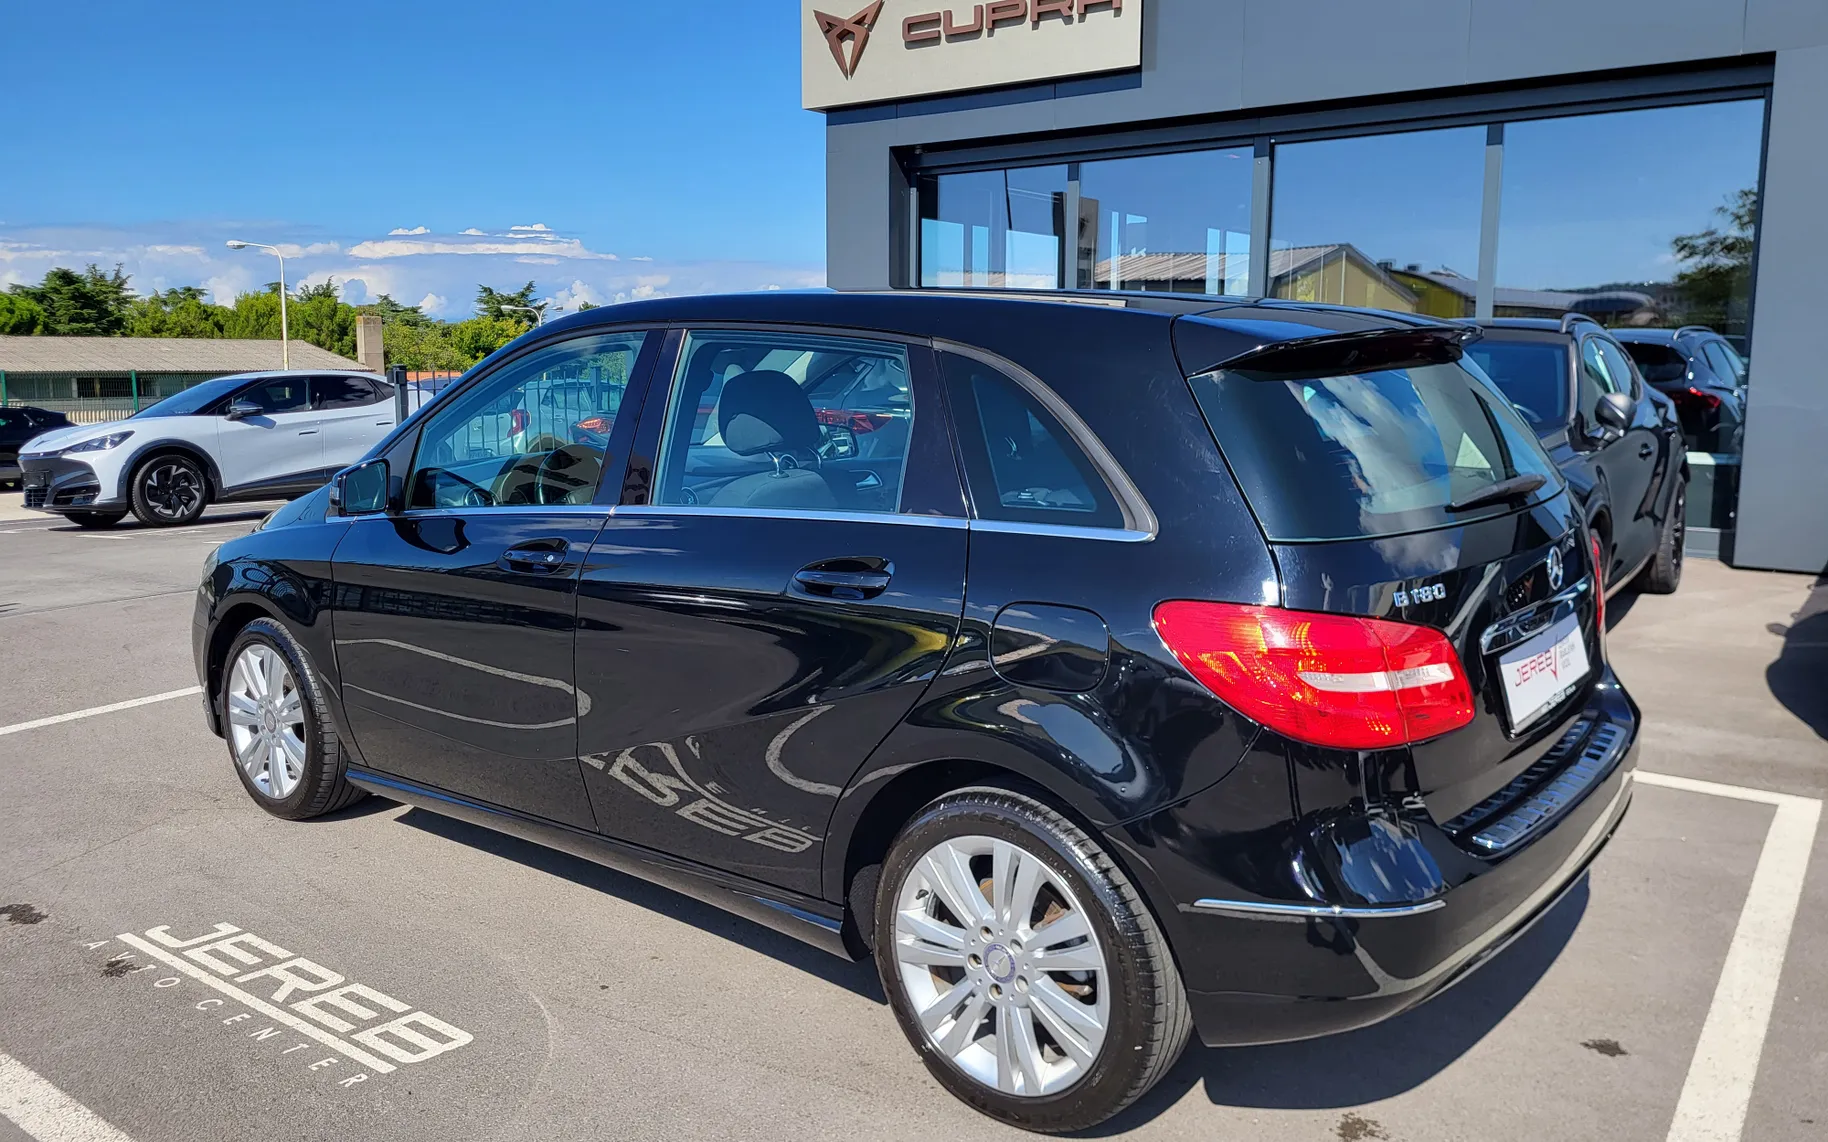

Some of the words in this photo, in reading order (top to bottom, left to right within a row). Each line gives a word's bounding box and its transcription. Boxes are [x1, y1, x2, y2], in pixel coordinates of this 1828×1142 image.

[1393, 591, 1410, 608] B
[1410, 583, 1447, 605] 180
[1514, 649, 1553, 687] JEREB
[82, 939, 181, 989] AVTO
[194, 998, 369, 1088] CENTER
[144, 921, 475, 1064] JEREB
